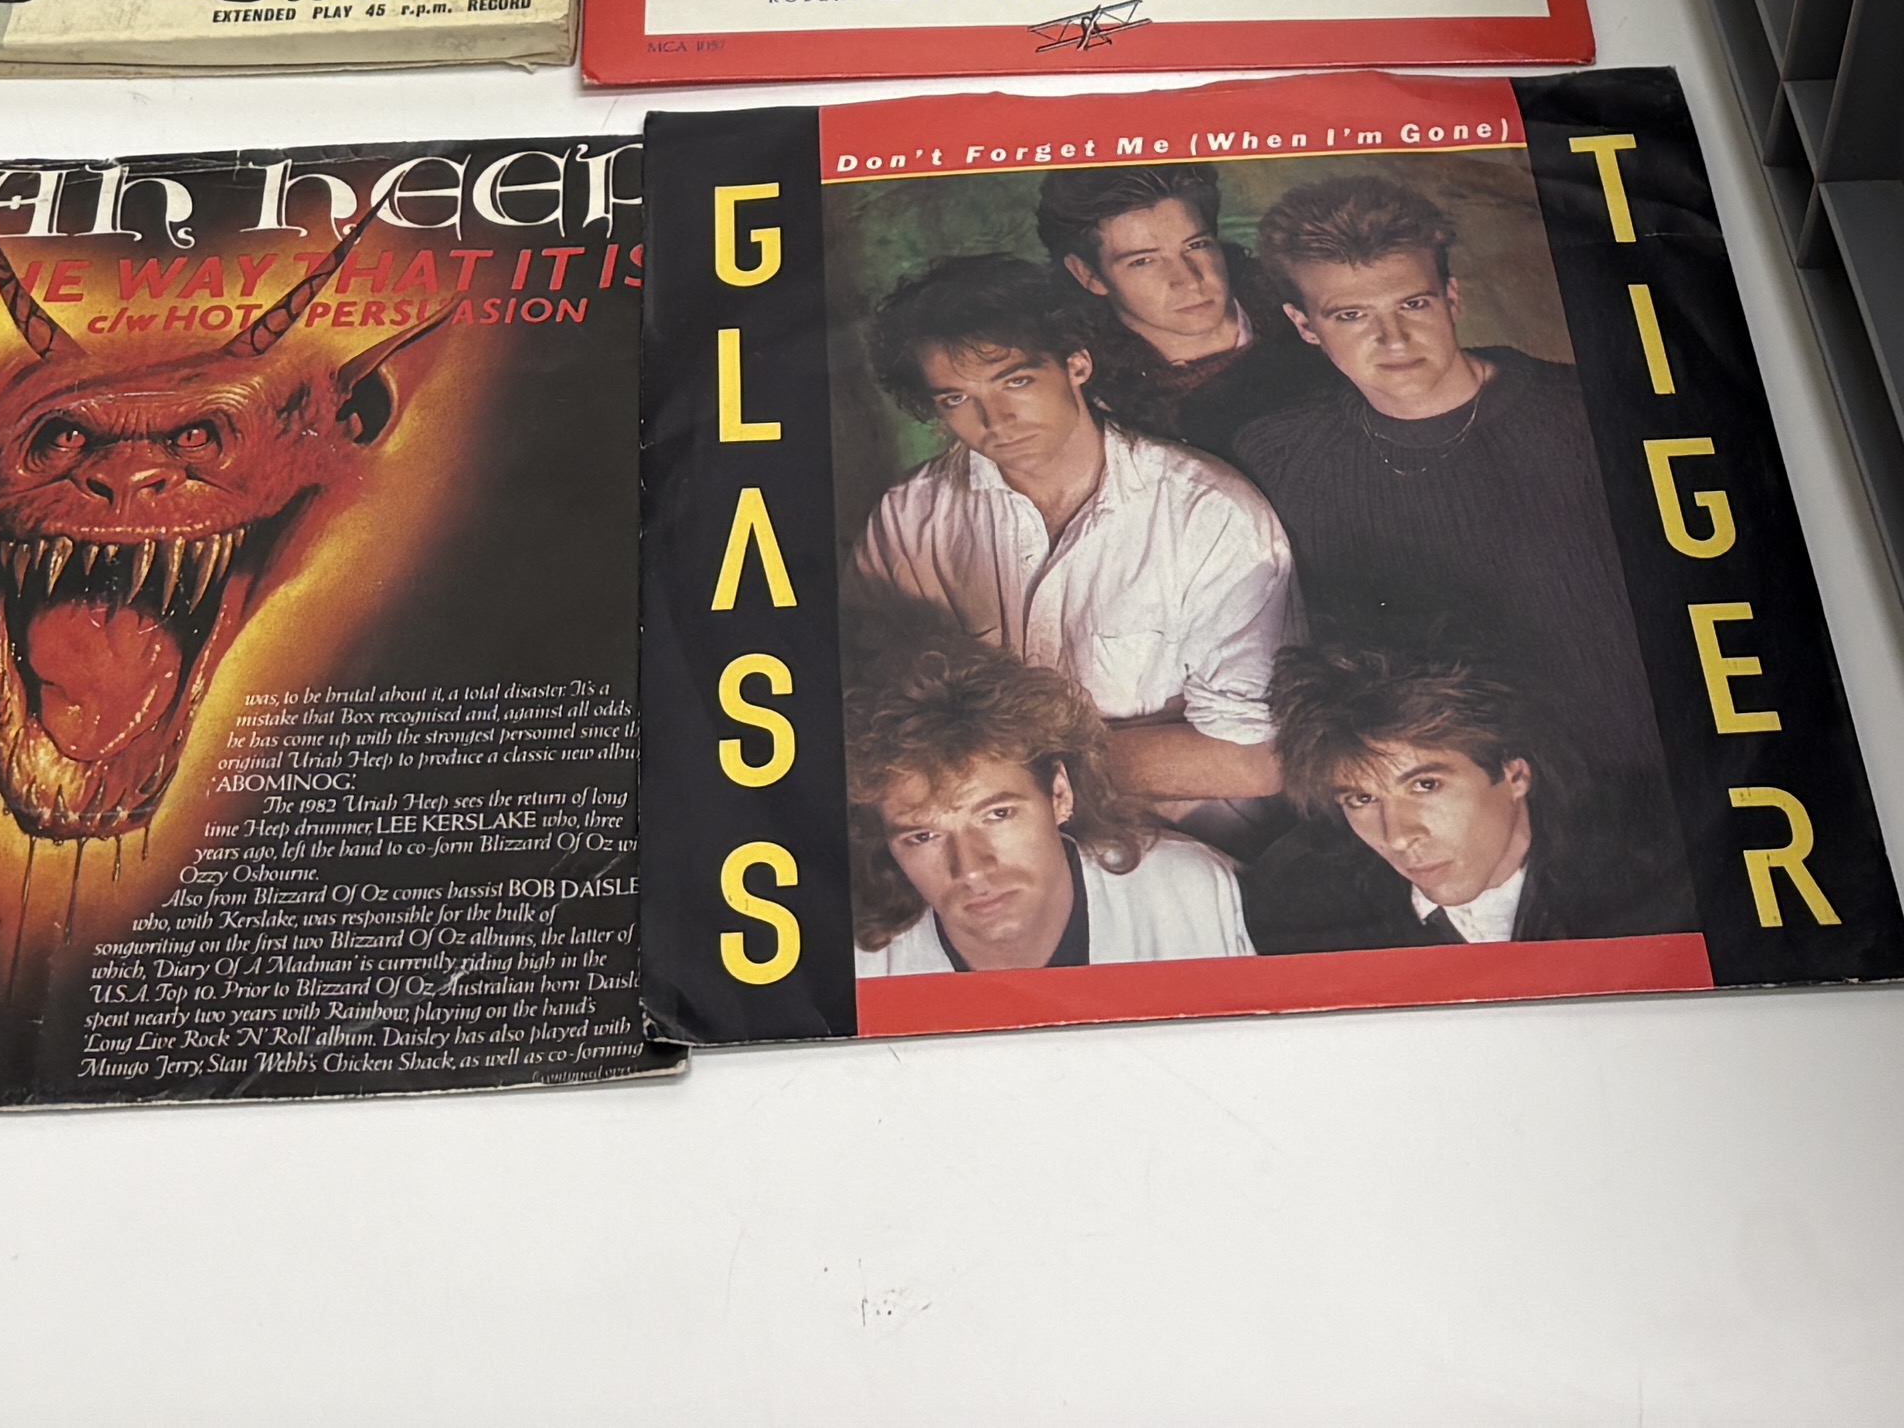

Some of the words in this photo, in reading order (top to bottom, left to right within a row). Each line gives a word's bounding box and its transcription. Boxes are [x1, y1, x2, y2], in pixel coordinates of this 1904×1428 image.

[212, 7, 297, 24] EXTENDED
[312, 4, 353, 20] PLAY
[364, 3, 387, 18] 45
[400, 2, 454, 19] r.p.m.
[835, 148, 943, 174] Don't
[964, 138, 1097, 164] Forget
[1115, 135, 1171, 156] Me
[1189, 132, 1308, 158] (When
[1326, 126, 1384, 147] I'm
[1398, 117, 1510, 145] Gone)
[117, 253, 280, 301] WAY
[510, 246, 587, 292] IT
[87, 304, 158, 335] c/w
[162, 301, 263, 332] HOT
[1567, 131, 1844, 931] TIGER
[376, 814, 417, 835] LEE
[422, 810, 538, 834] KERSLAKE
[508, 877, 556, 898] BOB
[77, 1056, 151, 1079] Mungo
[206, 1052, 249, 1075] Stan
[252, 1050, 321, 1075] Webb's
[323, 1048, 395, 1073] Chicken
[398, 1047, 457, 1073] Shack,
[458, 1053, 482, 1070] as
[484, 1046, 522, 1069] well
[524, 1050, 545, 1064] as
[547, 1041, 645, 1064] co-forming
